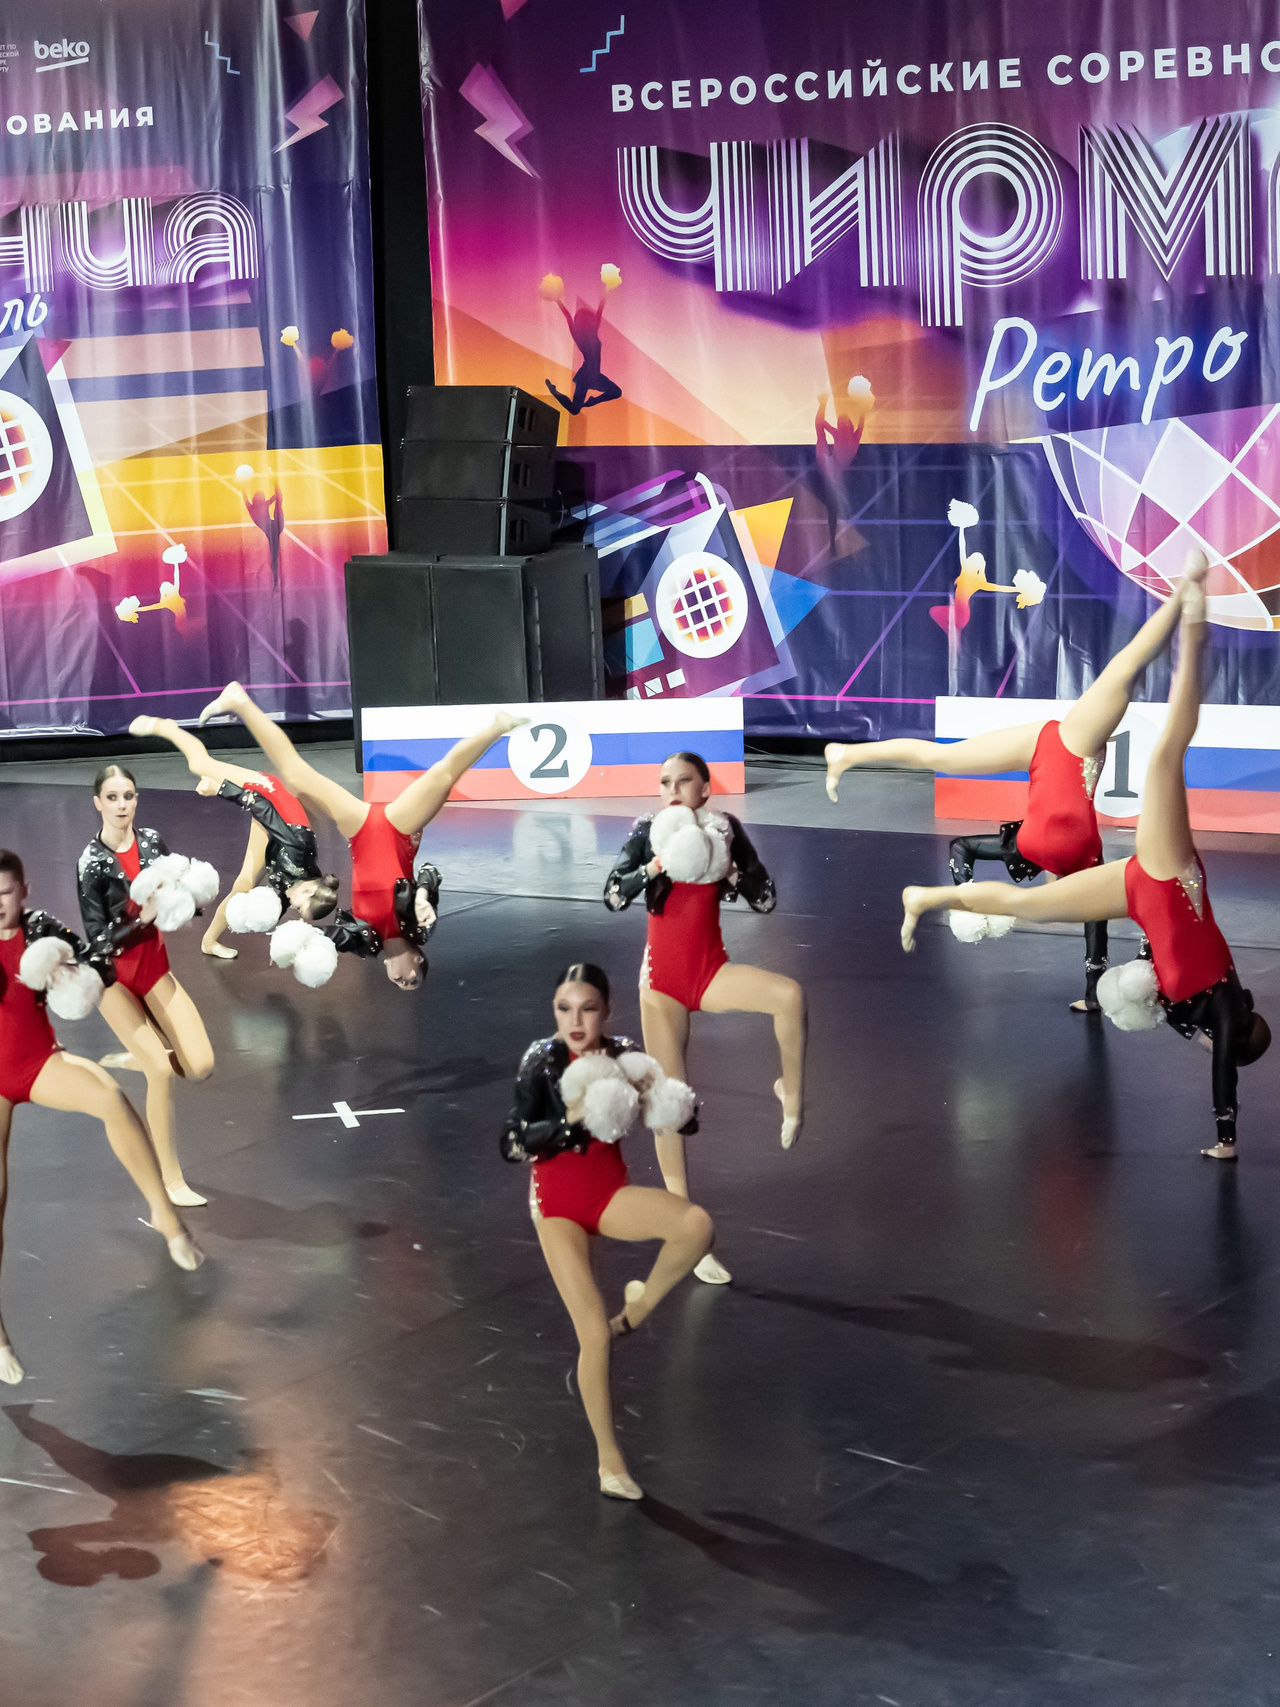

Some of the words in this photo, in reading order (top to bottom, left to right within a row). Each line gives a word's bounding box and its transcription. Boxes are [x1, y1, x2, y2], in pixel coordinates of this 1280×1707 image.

[34, 38, 90, 60] beko
[610, 58, 1022, 113] ВСЕРОССИЙСКИЕ
[617, 113, 1280, 327] ЧИРМ
[969, 316, 1250, 432] Ретро
[529, 723, 570, 779] 2
[1104, 730, 1139, 799] 1
